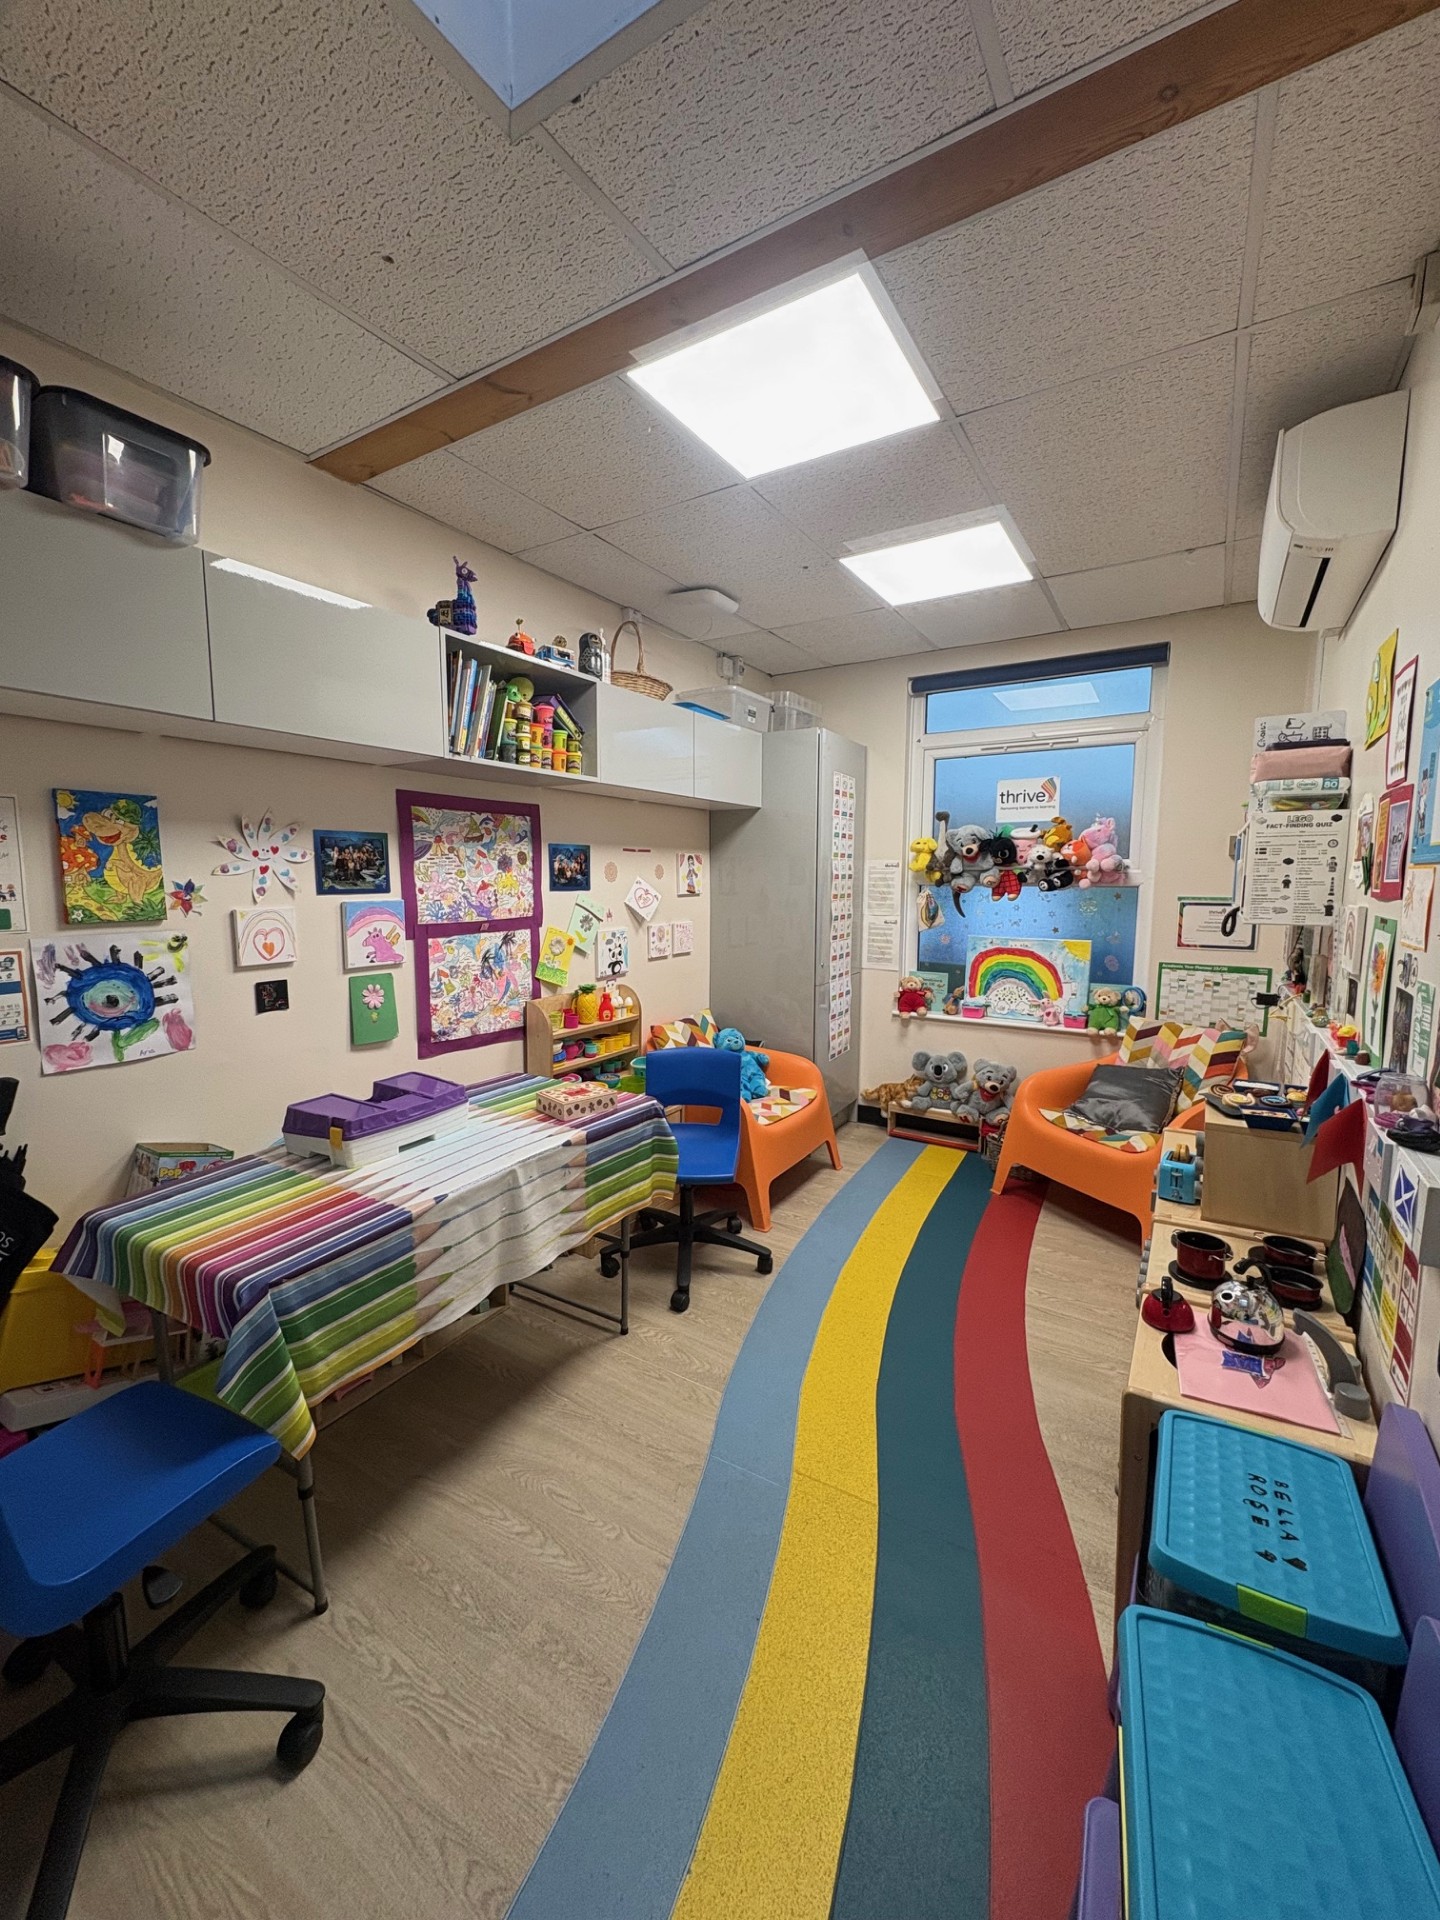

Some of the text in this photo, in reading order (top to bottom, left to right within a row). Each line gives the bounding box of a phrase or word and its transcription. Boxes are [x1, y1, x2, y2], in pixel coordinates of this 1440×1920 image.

[999, 789, 1046, 804] thrive
[1266, 821, 1313, 829] FACT-FINDING
[1286, 814, 1314, 823] LEGO
[1243, 1472, 1270, 1528] ROSE
[1274, 1479, 1300, 1542] BELLA
